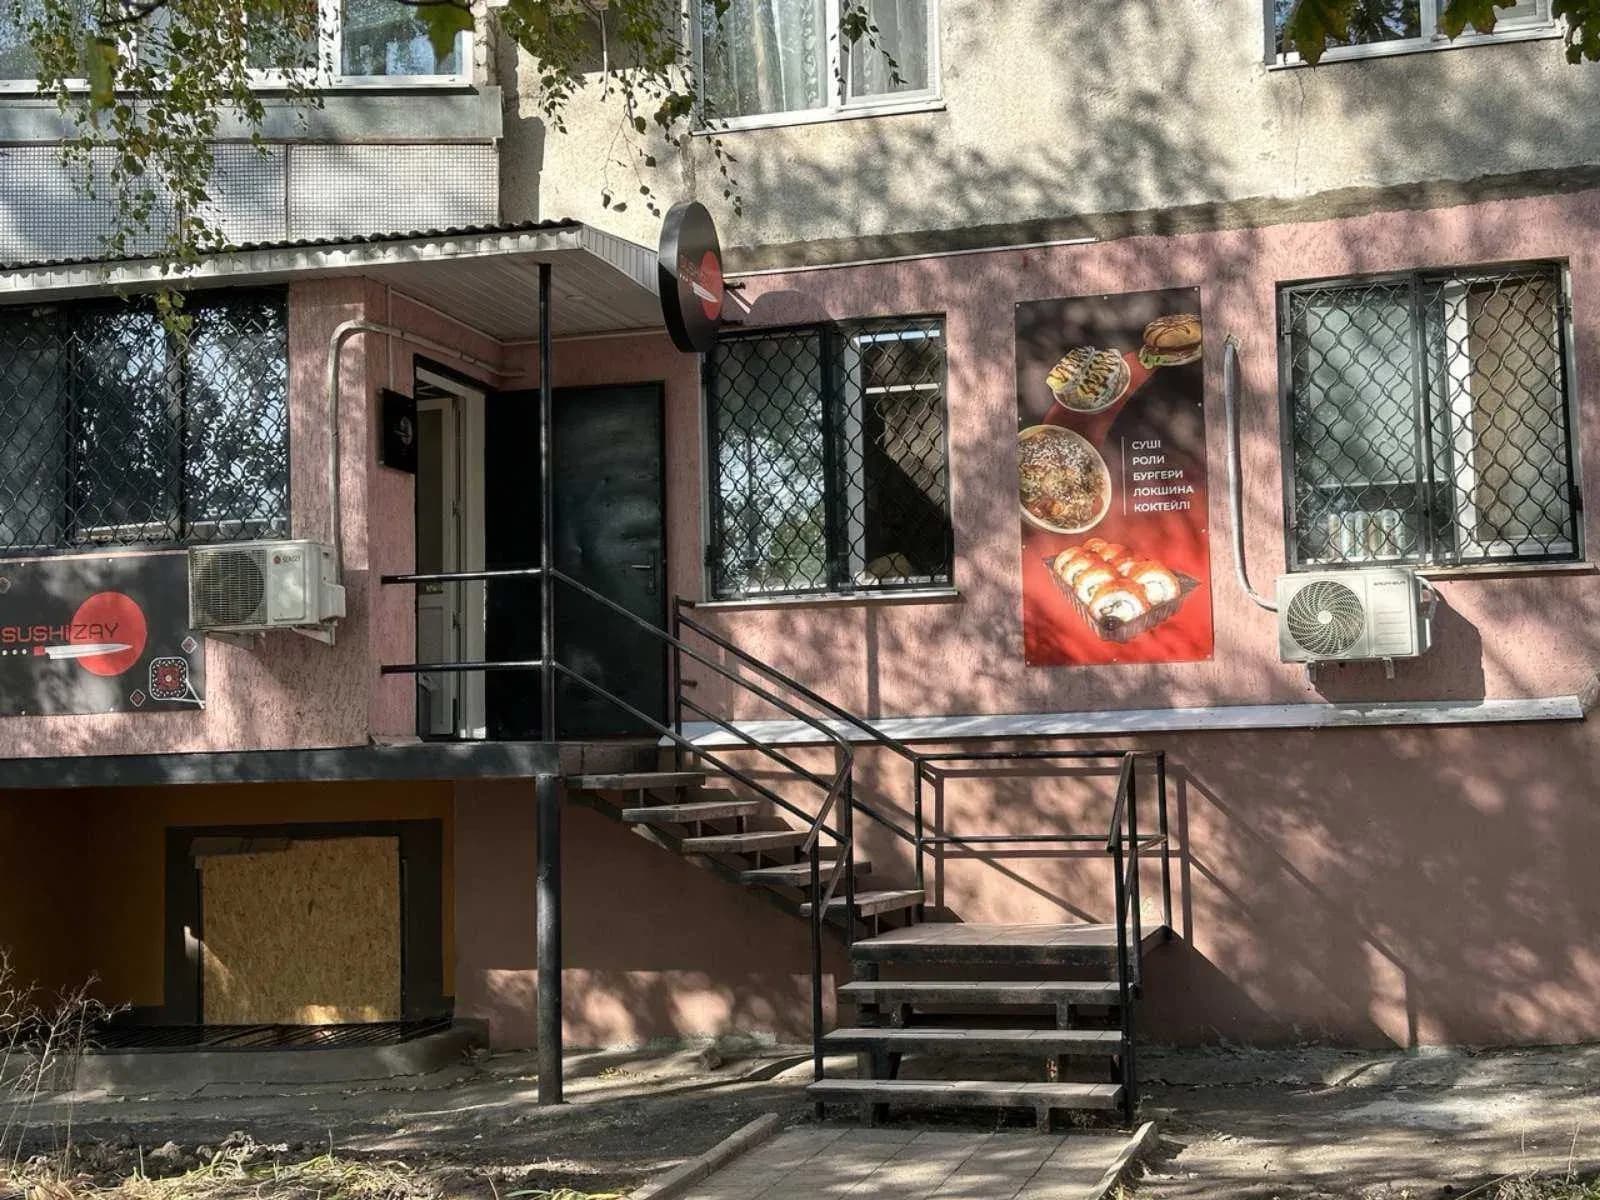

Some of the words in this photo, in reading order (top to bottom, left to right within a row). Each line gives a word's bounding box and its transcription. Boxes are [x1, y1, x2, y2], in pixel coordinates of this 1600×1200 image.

[1132, 440, 1161, 450] СУШІ
[1132, 455, 1165, 466] РОЛИ
[1133, 470, 1184, 481] БУРГЕРИ
[1133, 485, 1195, 497] ЛОКШИНА
[1134, 500, 1191, 513] КОКТЕЙЛІ
